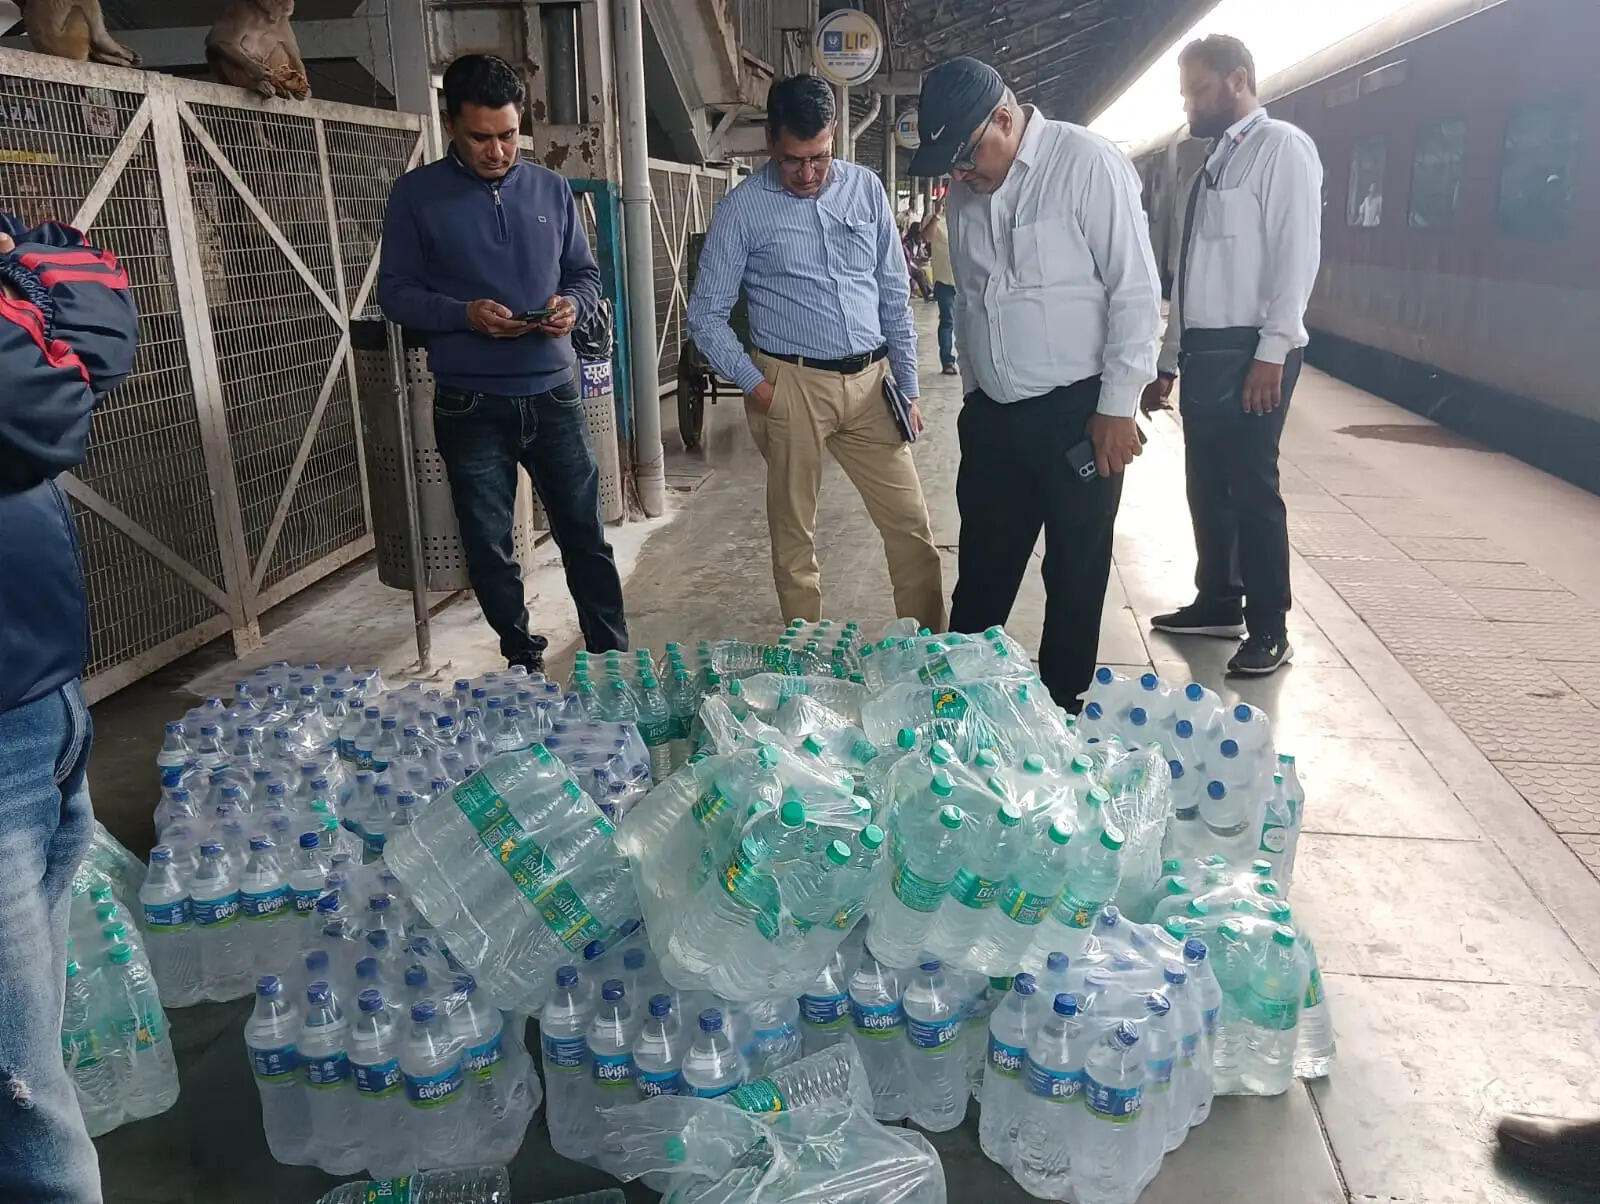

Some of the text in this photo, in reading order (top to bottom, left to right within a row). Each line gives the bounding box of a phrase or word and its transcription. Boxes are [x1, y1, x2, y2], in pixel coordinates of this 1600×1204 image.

[845, 32, 869, 50] LIC
[864, 1015, 893, 1030] Elvish
[993, 1050, 1022, 1069] Elvish
[599, 1064, 629, 1081] Elvish
[419, 1081, 452, 1099] Elvish
